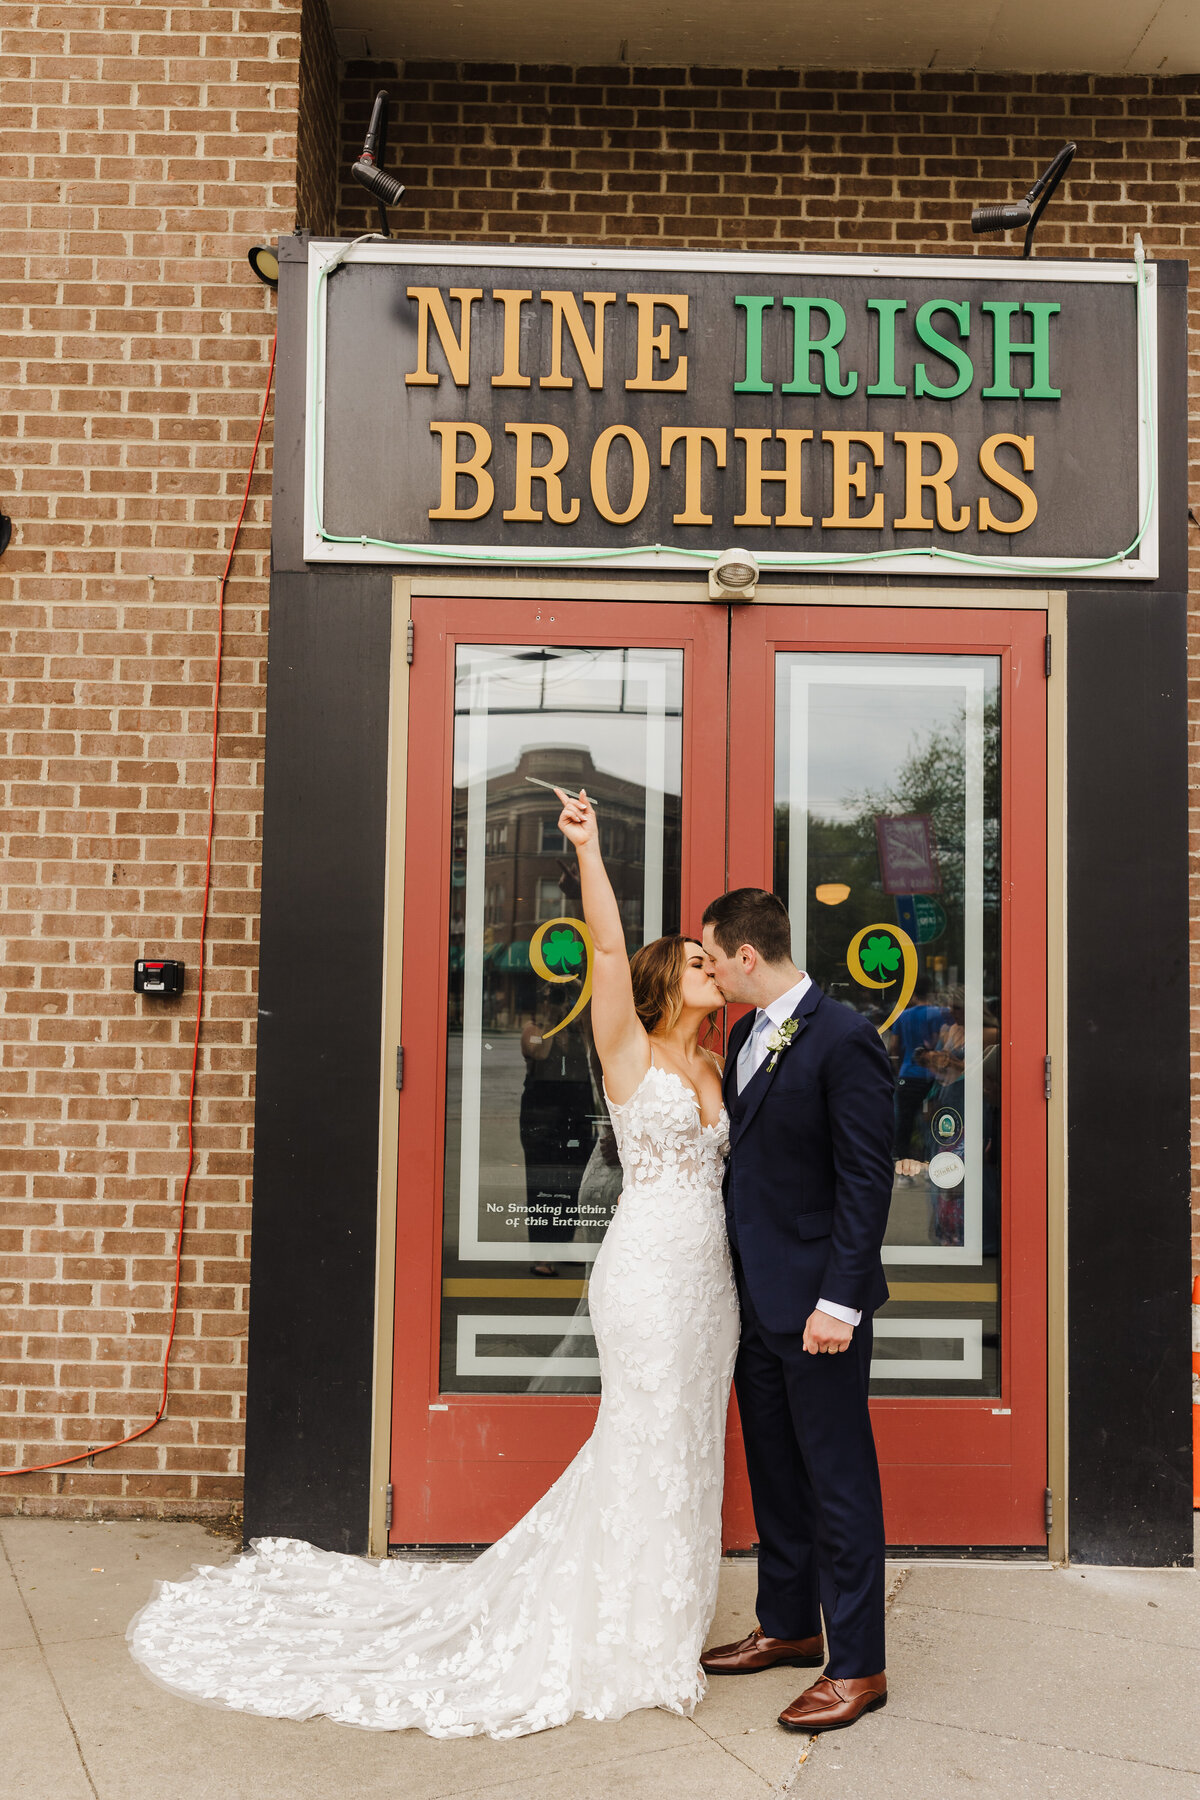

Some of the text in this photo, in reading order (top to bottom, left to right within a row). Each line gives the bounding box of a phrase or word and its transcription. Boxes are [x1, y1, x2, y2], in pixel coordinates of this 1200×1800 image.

[405, 286, 1062, 400] NINE IRISH
[428, 421, 1039, 534] BROTHERS
[528, 917, 595, 1039] 9
[846, 922, 919, 1035] 9
[486, 1203, 504, 1213] No
[508, 1203, 562, 1215] Smoking
[565, 1204, 607, 1214] within
[505, 1216, 611, 1227] of this Entrance
